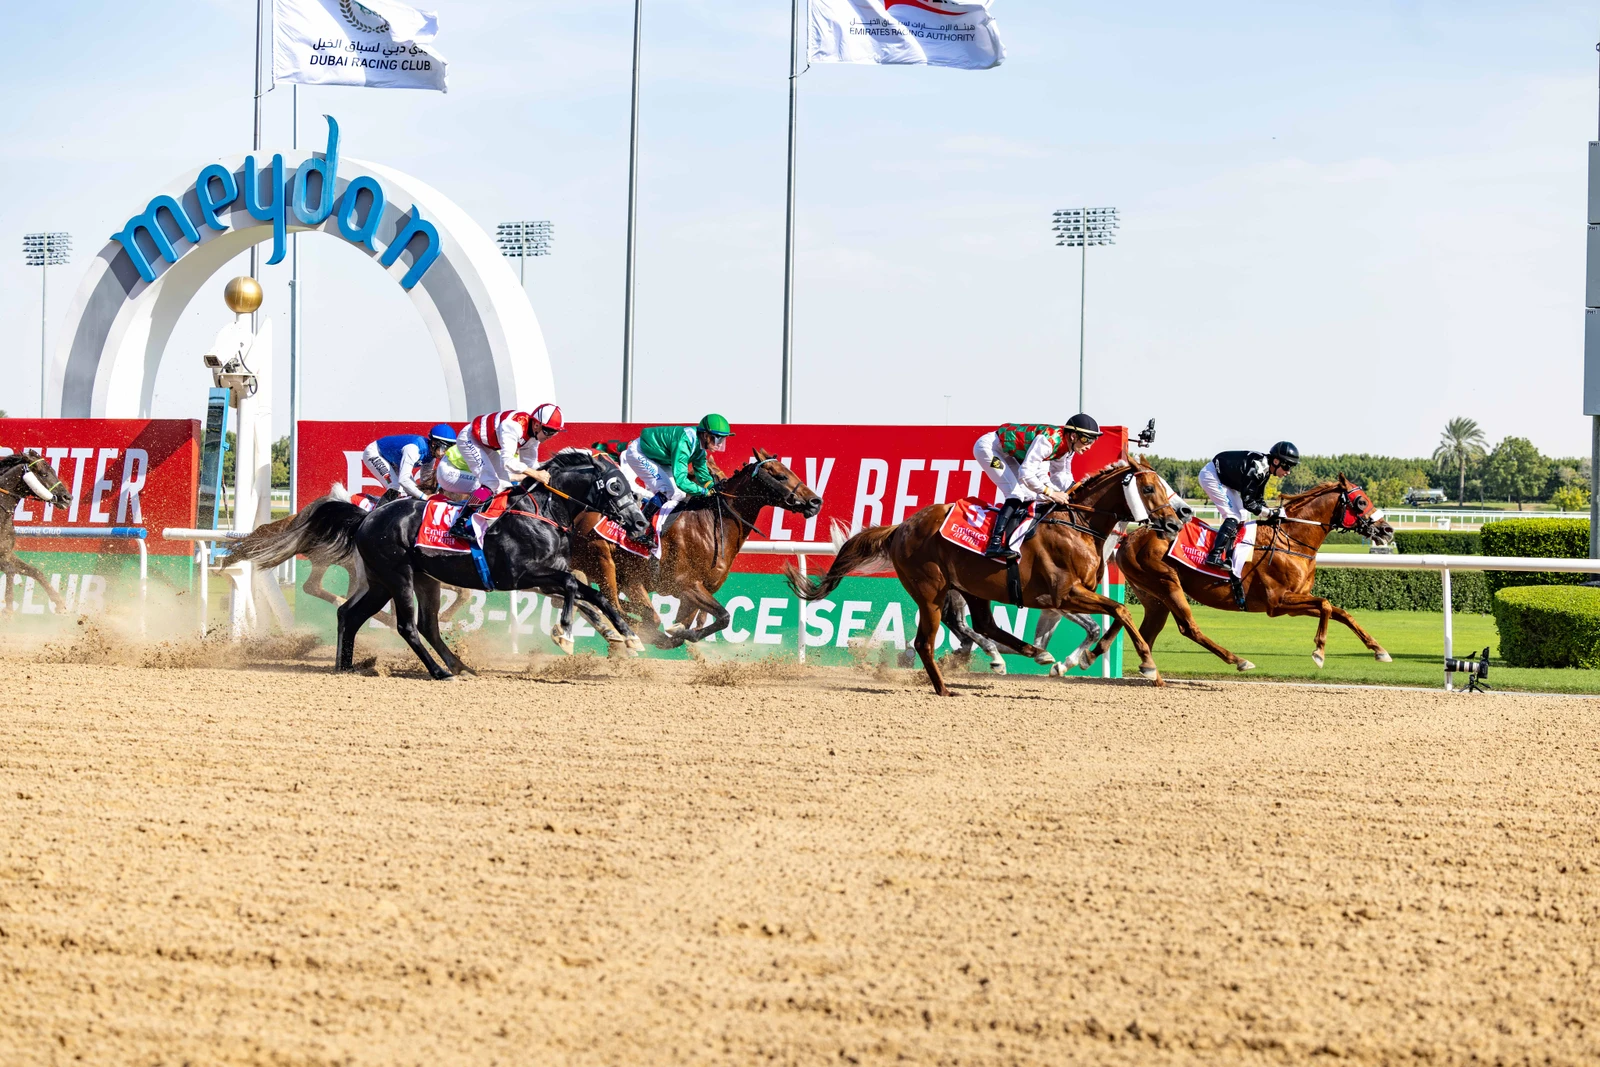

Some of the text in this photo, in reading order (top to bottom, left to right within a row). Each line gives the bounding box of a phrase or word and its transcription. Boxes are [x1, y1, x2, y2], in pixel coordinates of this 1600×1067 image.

[850, 27, 890, 36] EMIRATES
[926, 31, 975, 42] AUTHORITY
[310, 55, 431, 71] DUBAI RACING CLUB
[109, 114, 444, 290] meydan
[593, 479, 605, 490] 13
[951, 523, 988, 542] Emirates
